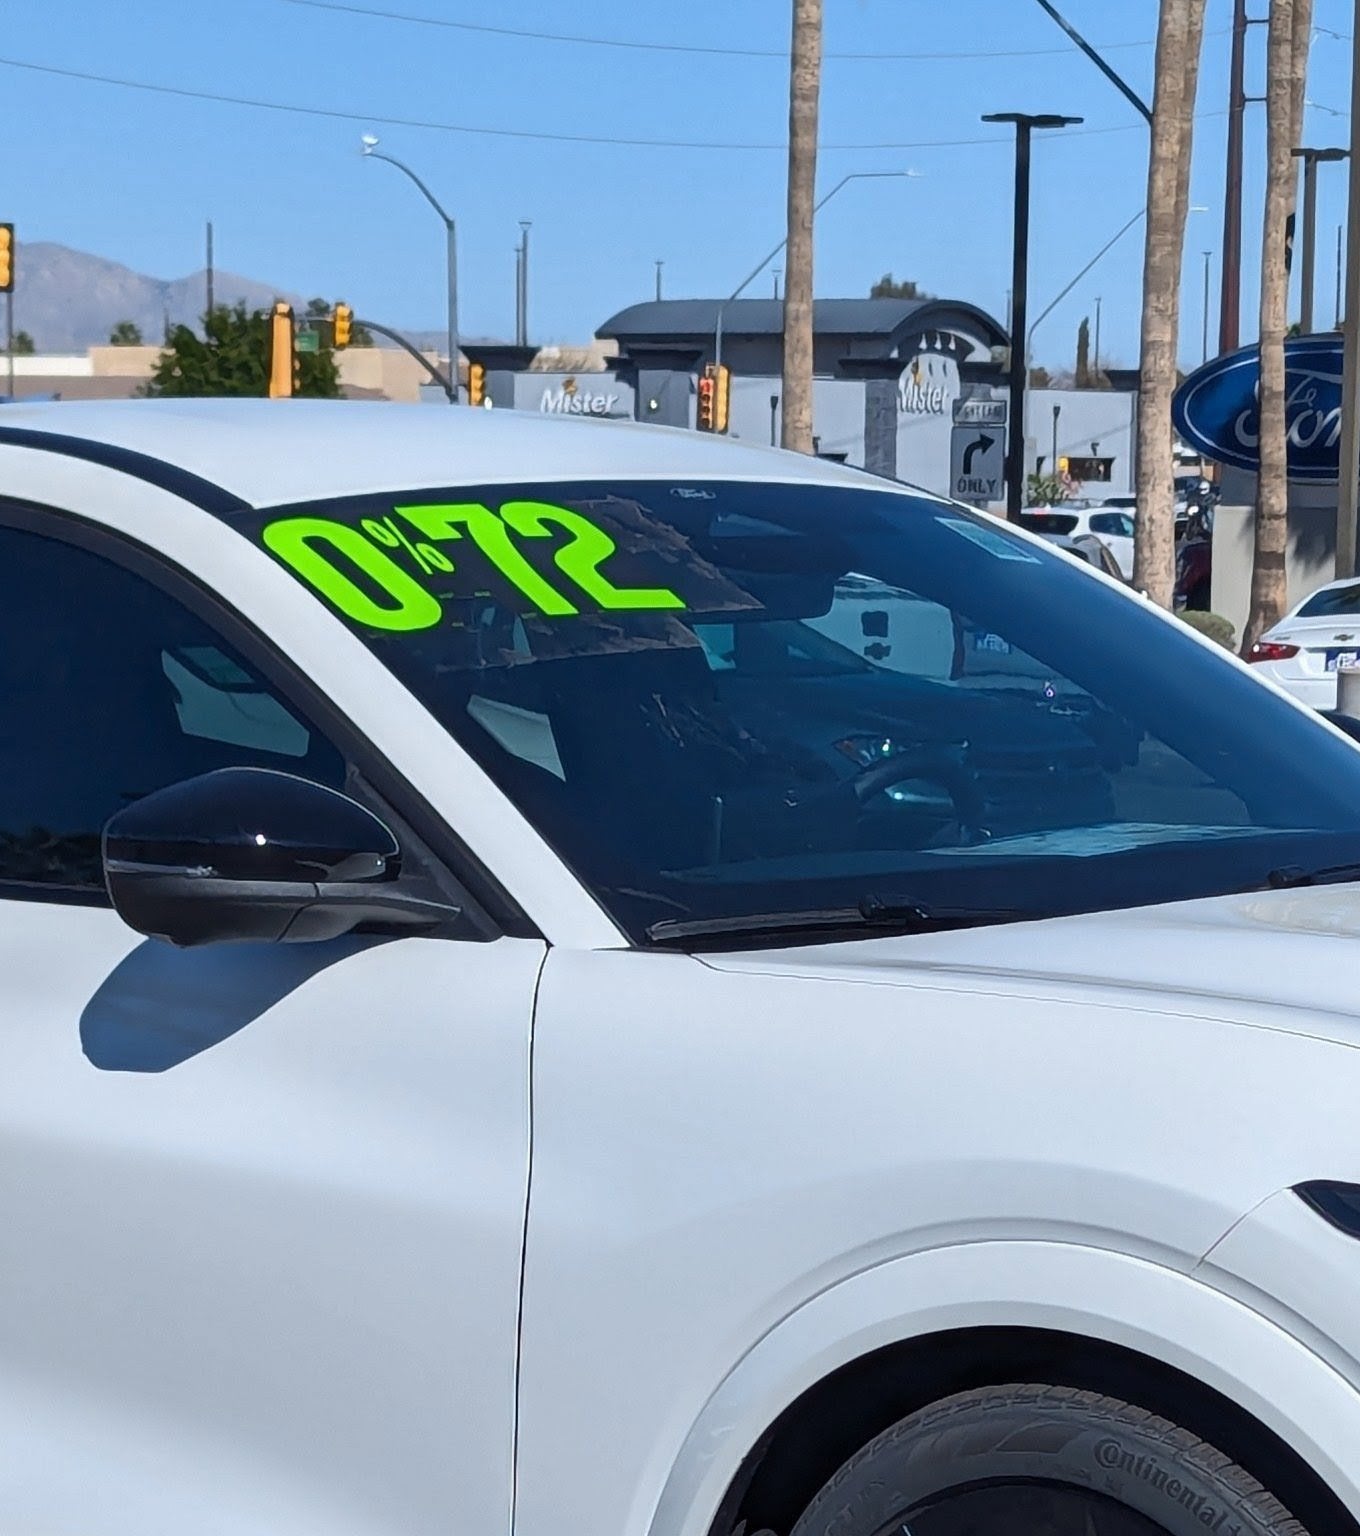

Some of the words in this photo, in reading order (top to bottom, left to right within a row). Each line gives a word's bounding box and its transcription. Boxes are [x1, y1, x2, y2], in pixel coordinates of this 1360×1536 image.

[541, 389, 618, 415] Mister
[957, 477, 997, 494] ONLY
[1094, 1438, 1228, 1533] Continental
